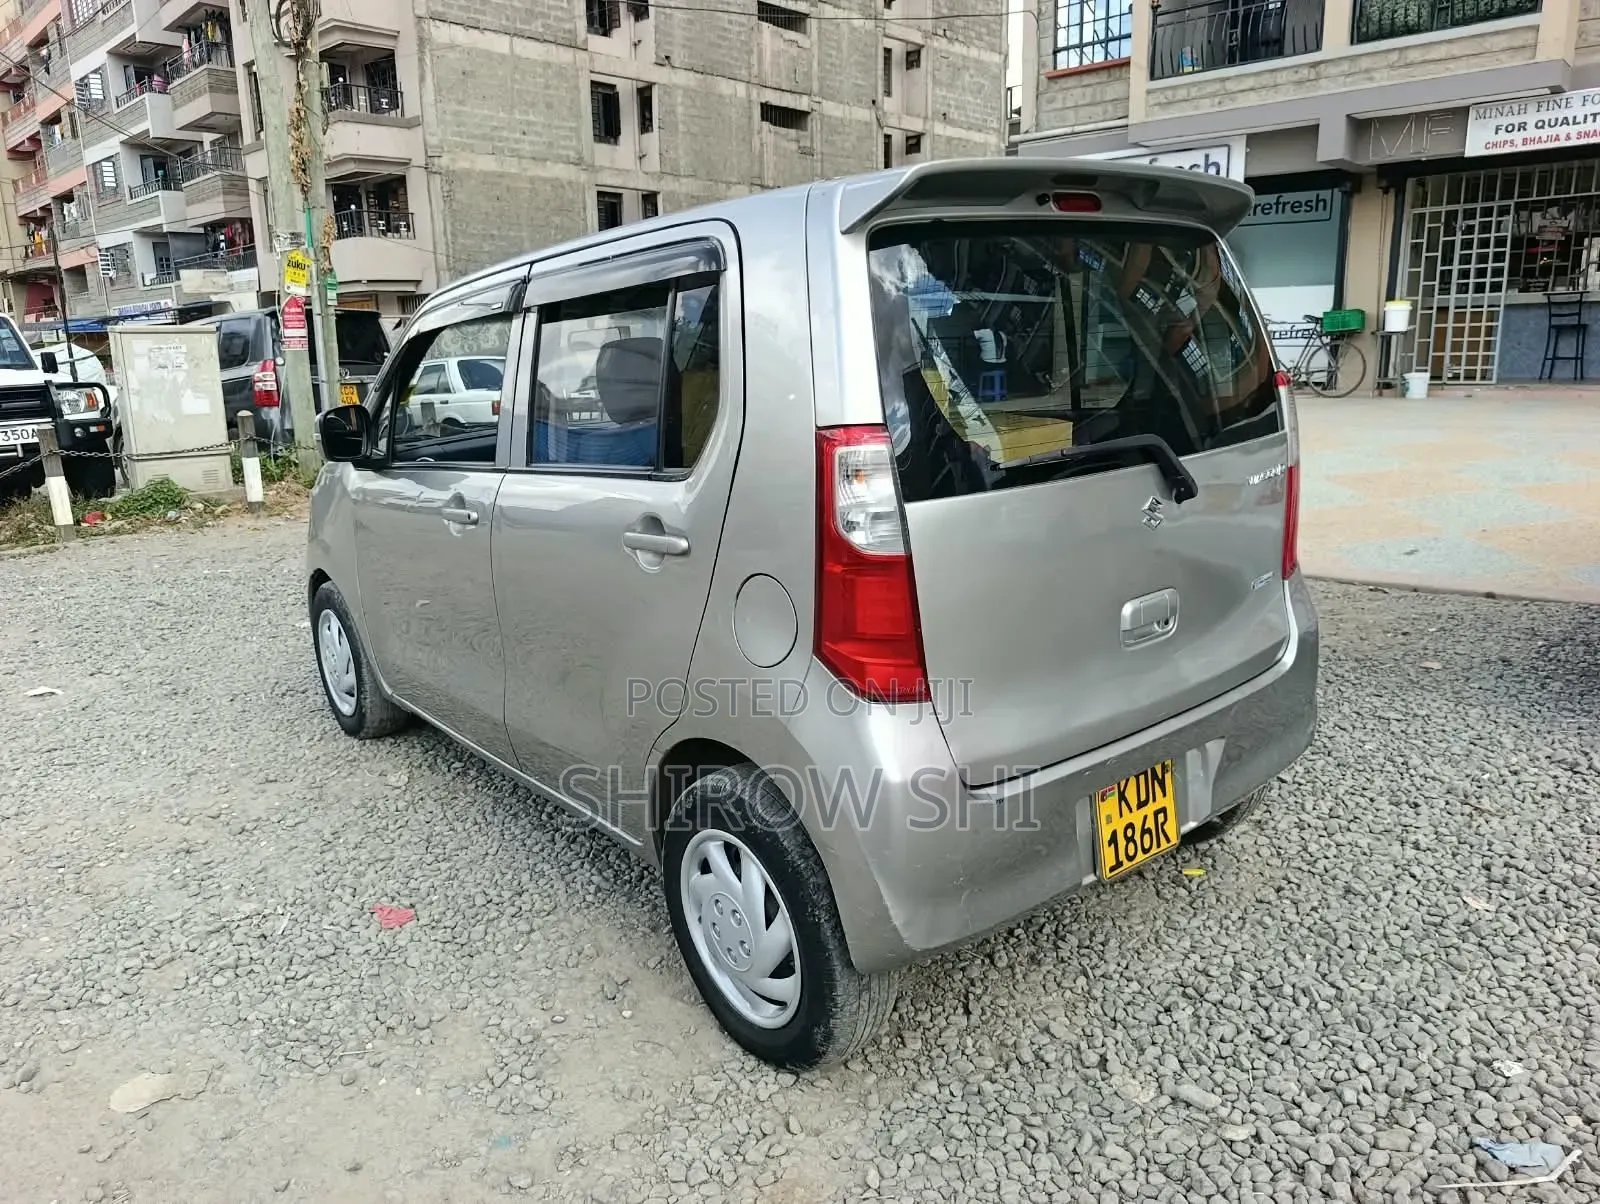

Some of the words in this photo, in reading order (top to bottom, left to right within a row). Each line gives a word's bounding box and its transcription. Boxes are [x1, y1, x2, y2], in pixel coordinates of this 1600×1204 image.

[1475, 104, 1528, 120] MINAH
[1536, 97, 1574, 112] FINE
[1495, 121, 1527, 135] FOR
[1535, 112, 1600, 130] QUALIT
[1485, 139, 1518, 151] CHIPS,
[1522, 133, 1560, 146] BHAJIA
[1565, 132, 1572, 141] &
[1576, 129, 1600, 140] SNA
[287, 259, 306, 271] zuku
[1116, 761, 1168, 818] KDN
[1107, 806, 1172, 874] 186R
